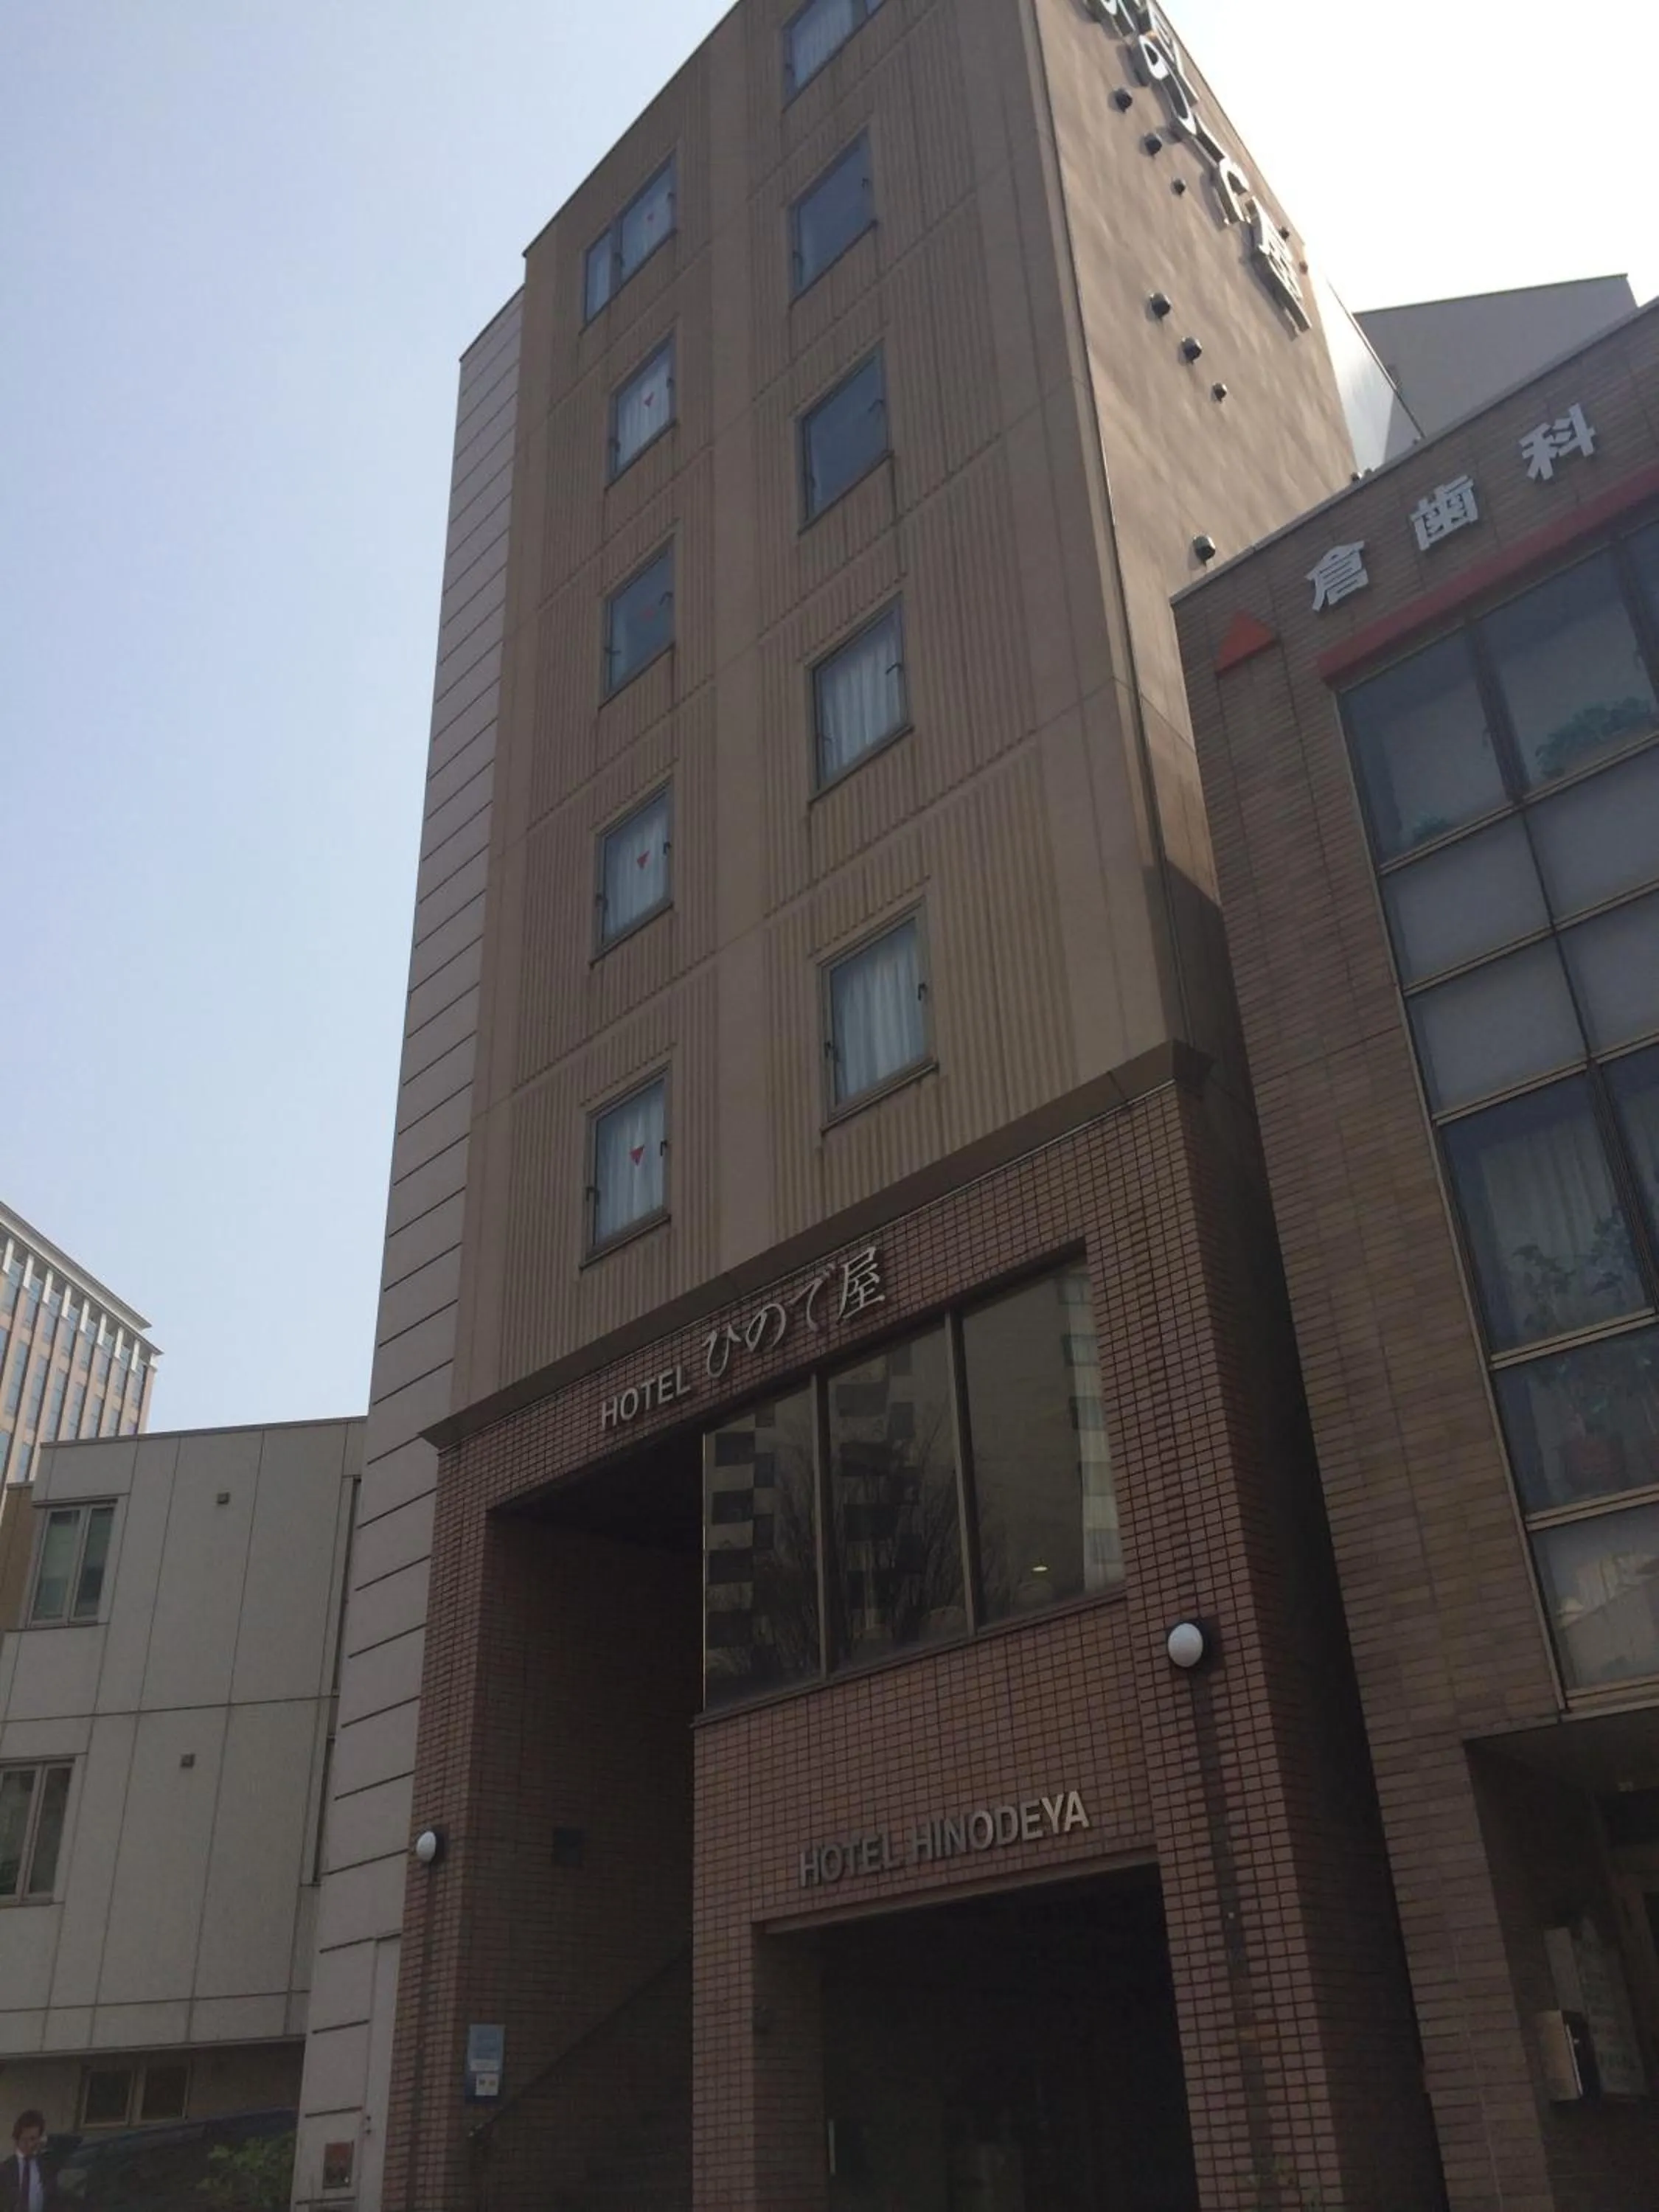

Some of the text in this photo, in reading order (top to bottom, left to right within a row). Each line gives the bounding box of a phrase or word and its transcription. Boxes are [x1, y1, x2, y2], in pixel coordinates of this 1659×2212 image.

[601, 1246, 886, 1430] HOTEL ひので屋
[799, 1790, 1091, 1888] HOTEL HINODEYA
